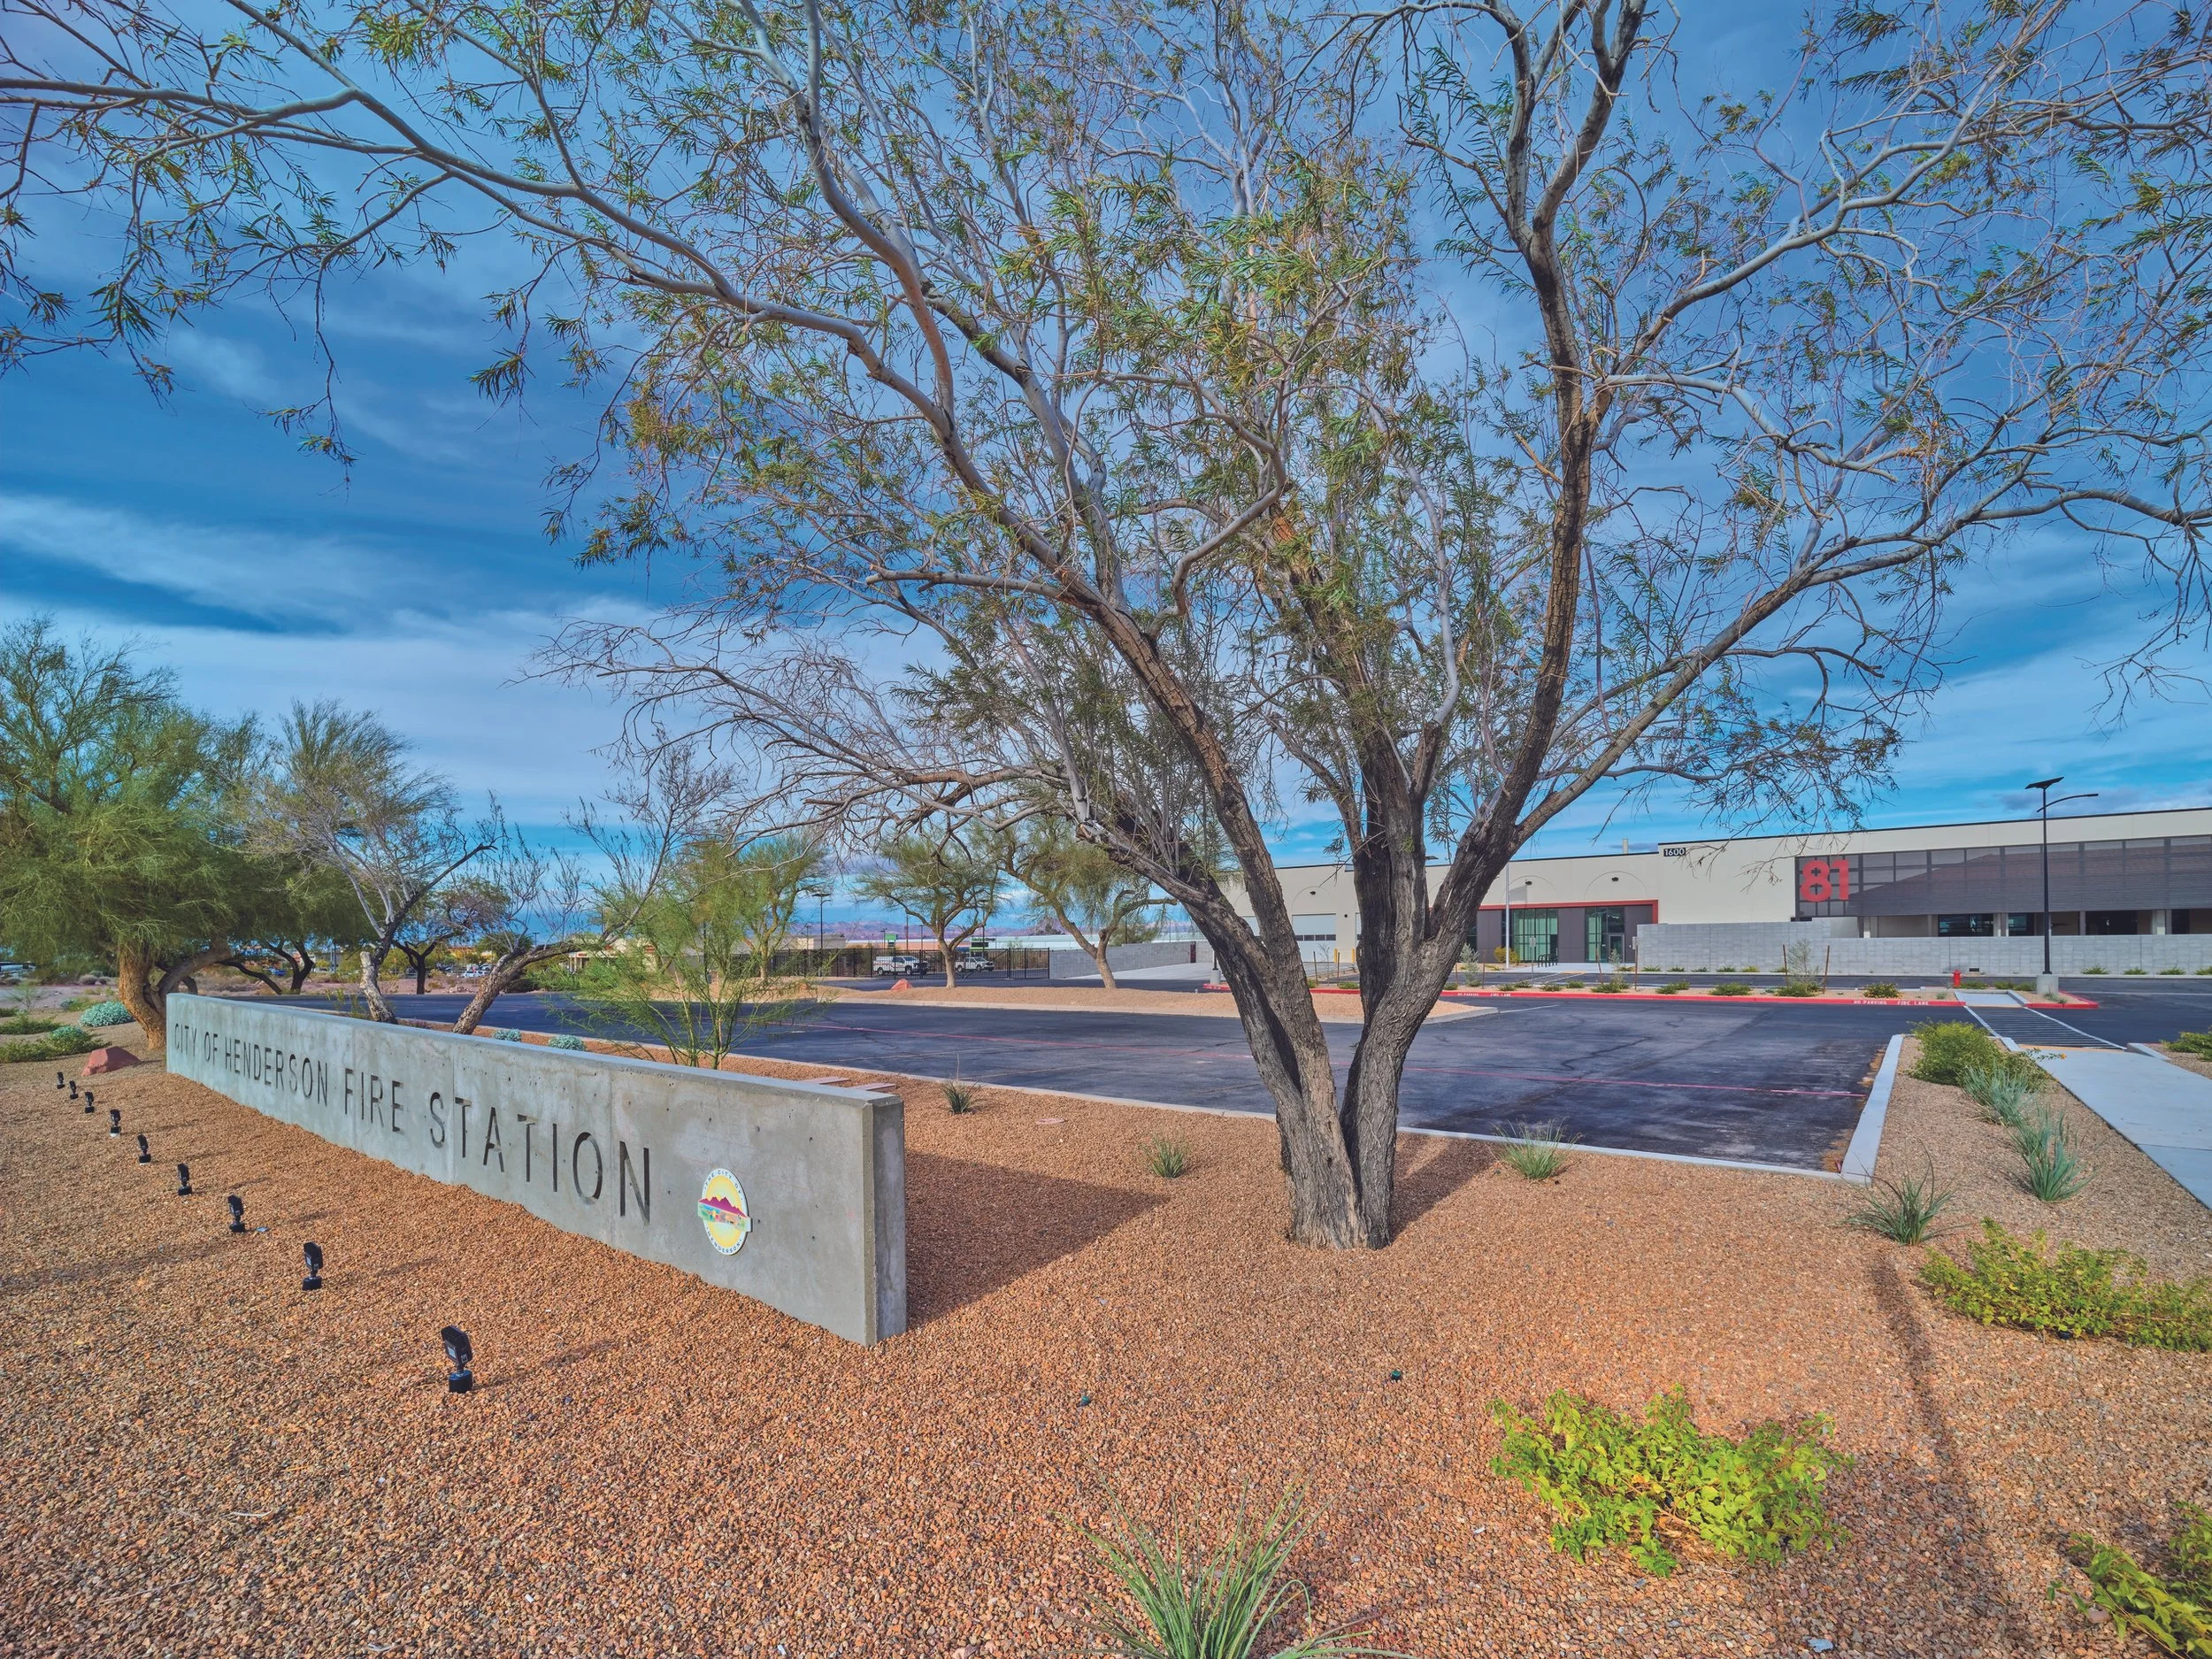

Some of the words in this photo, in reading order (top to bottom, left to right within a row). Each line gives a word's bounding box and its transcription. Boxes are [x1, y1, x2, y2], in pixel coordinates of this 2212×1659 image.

[1801, 859, 1849, 902] 81
[174, 1023, 196, 1057] CITY
[204, 1031, 219, 1066] OF
[225, 1036, 328, 1107] HENDERSON
[344, 1068, 404, 1135] FIRE
[430, 1091, 650, 1225] STATION
[705, 1172, 714, 1186] THE
[718, 1170, 732, 1179] CITY
[735, 1183, 741, 1194] OF
[708, 1231, 740, 1253] HENDERSON
